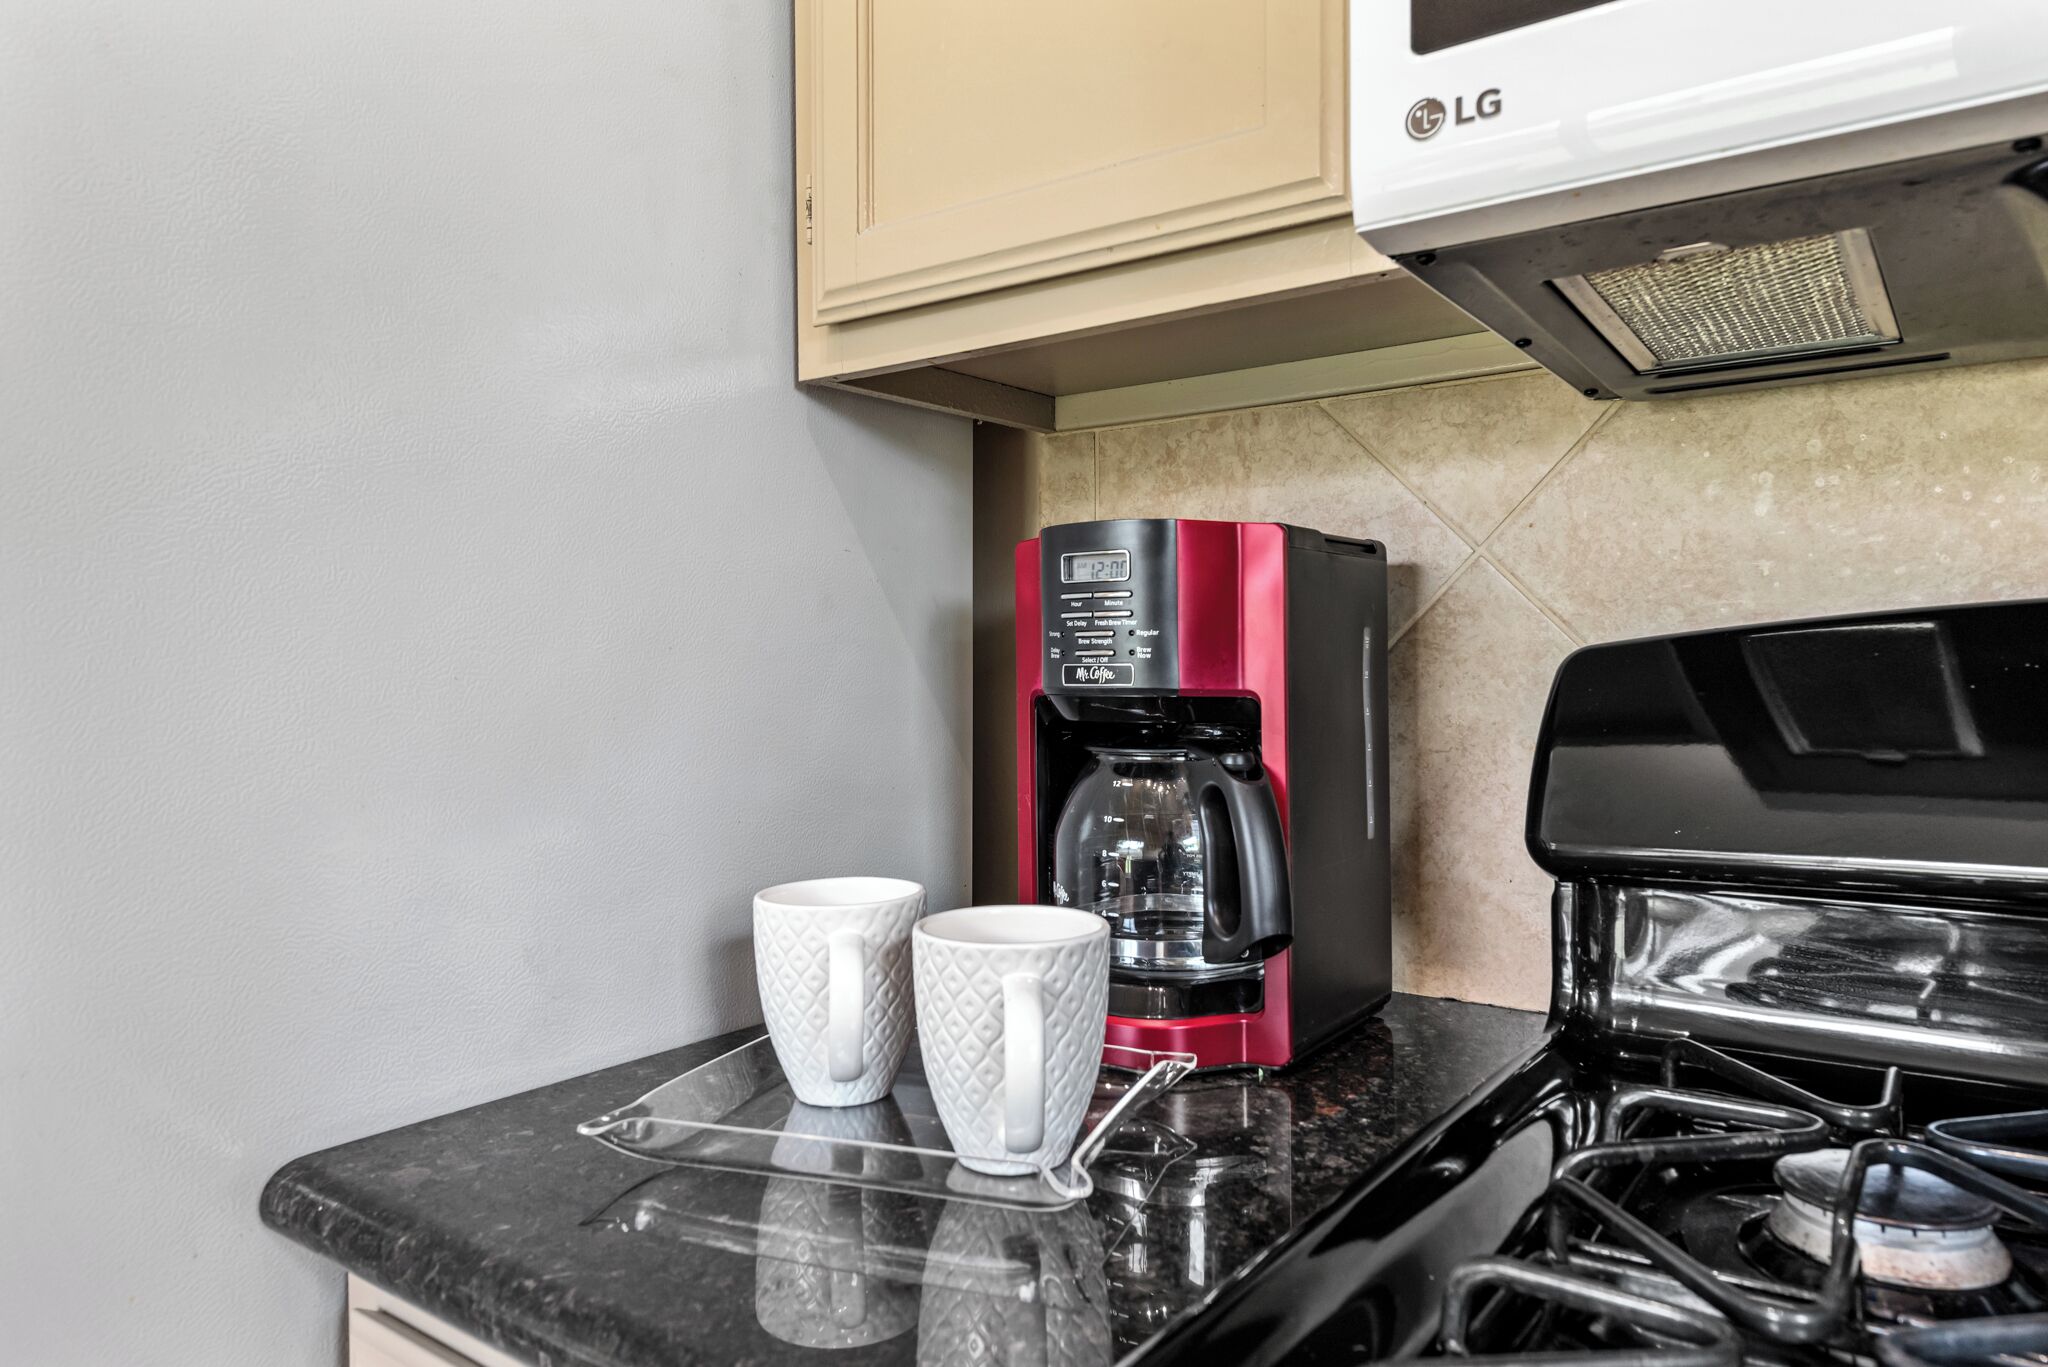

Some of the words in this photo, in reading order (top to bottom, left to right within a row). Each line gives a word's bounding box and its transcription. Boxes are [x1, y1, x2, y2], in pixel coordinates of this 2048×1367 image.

[1455, 88, 1502, 126] LG
[1136, 630, 1160, 638] Regular
[1090, 666, 1116, 684] Coffee
